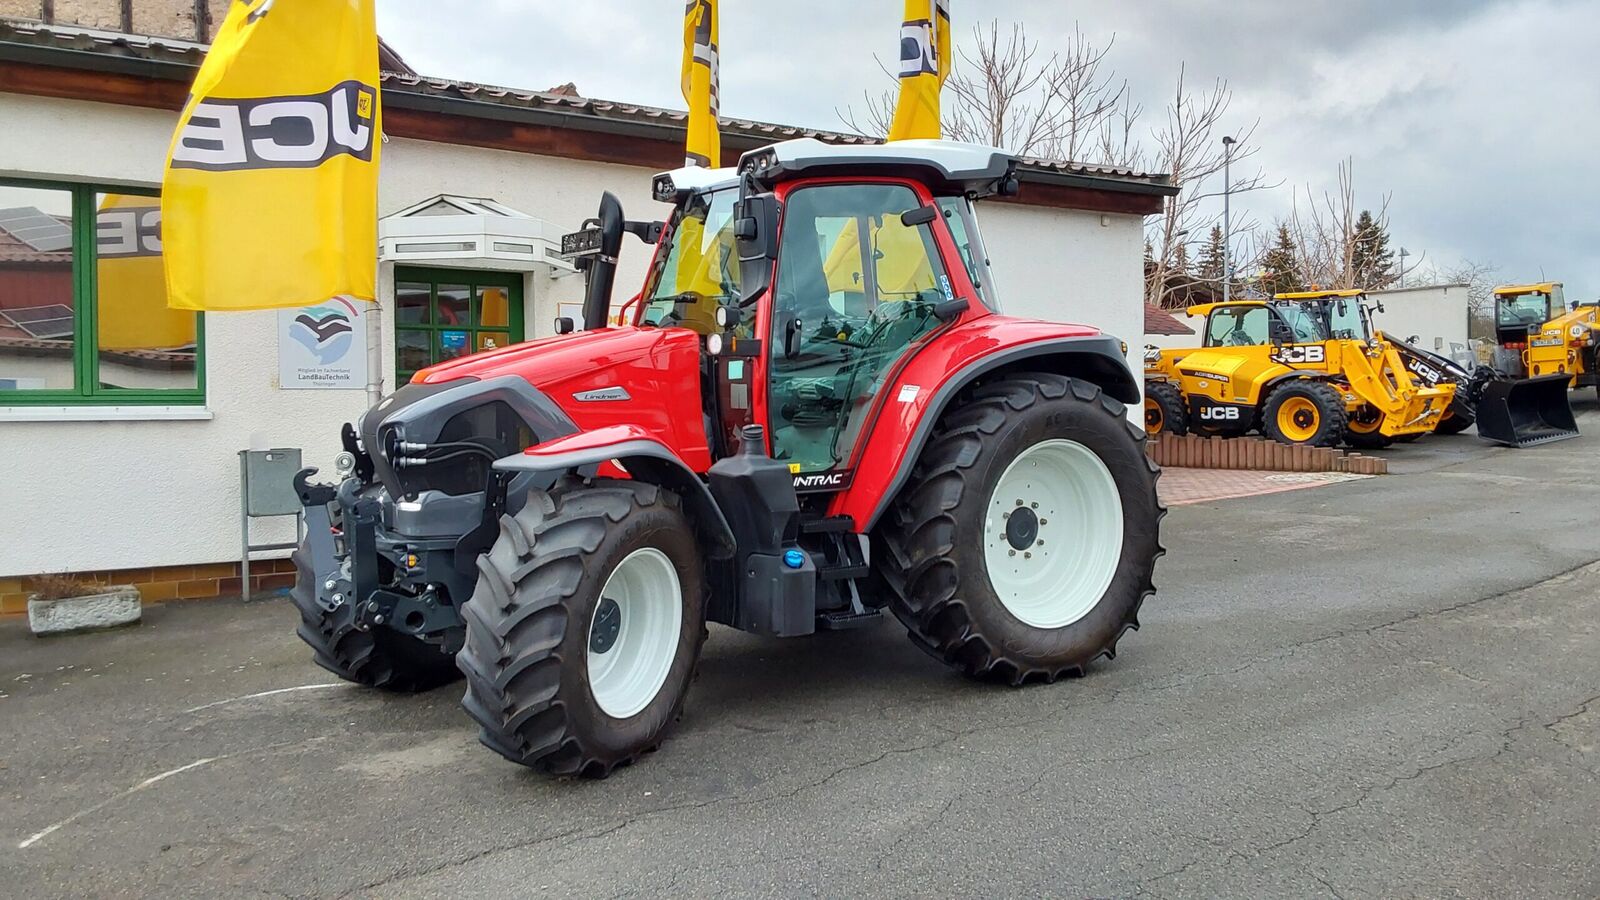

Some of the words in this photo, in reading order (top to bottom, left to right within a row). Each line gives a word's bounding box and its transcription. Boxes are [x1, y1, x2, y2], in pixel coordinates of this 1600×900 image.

[1271, 346, 1324, 363] JCB
[1409, 360, 1440, 383] JCB
[1200, 406, 1240, 420] JCB
[793, 473, 843, 487] INTRAC
